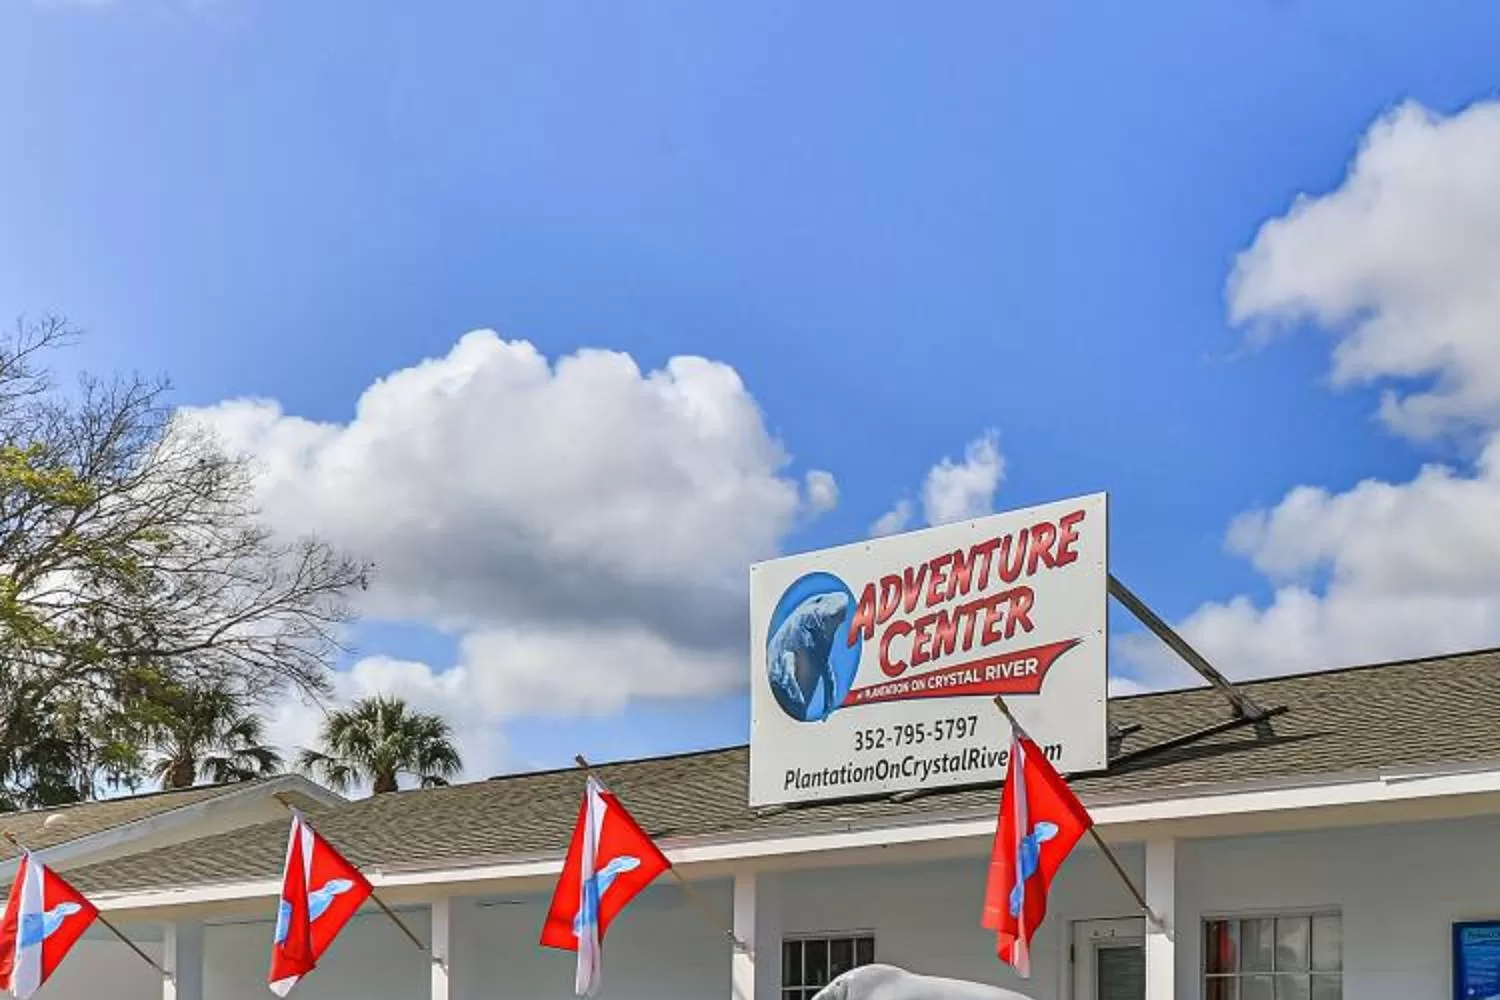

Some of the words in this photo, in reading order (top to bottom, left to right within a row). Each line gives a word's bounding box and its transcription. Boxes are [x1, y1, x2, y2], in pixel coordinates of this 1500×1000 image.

[847, 509, 1086, 648] ADVENTURE
[879, 585, 1035, 678] CENTER
[911, 679, 927, 691] ON
[927, 671, 981, 689] CRYSTAL
[985, 657, 1039, 681] RIVER
[855, 716, 978, 751] 352-795-5797
[784, 742, 1063, 790] PlantationOnCrystalRivem
